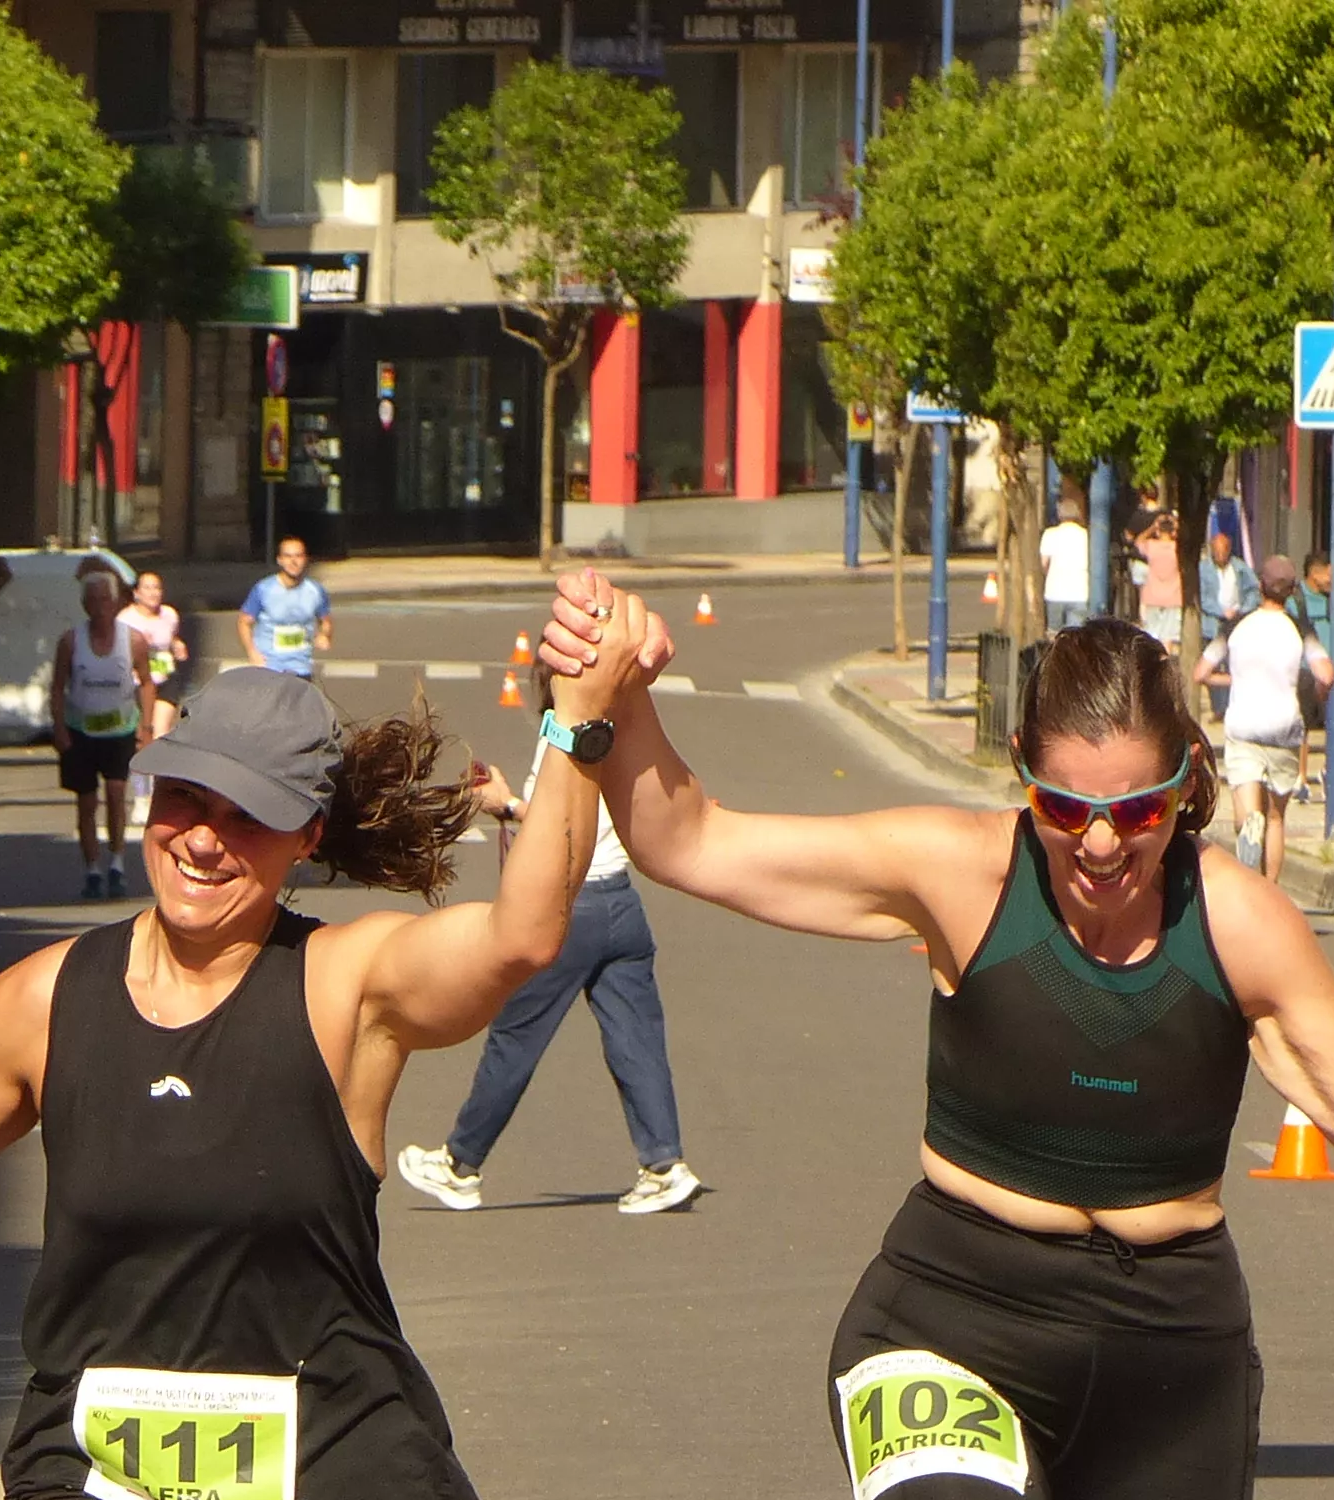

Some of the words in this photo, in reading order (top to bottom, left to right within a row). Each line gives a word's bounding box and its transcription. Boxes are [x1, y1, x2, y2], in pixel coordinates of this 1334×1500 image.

[1071, 1071, 1138, 1094] hummel
[859, 1380, 1001, 1446] 102
[105, 1417, 255, 1484] 111
[869, 1432, 986, 1467] PATRICIA
